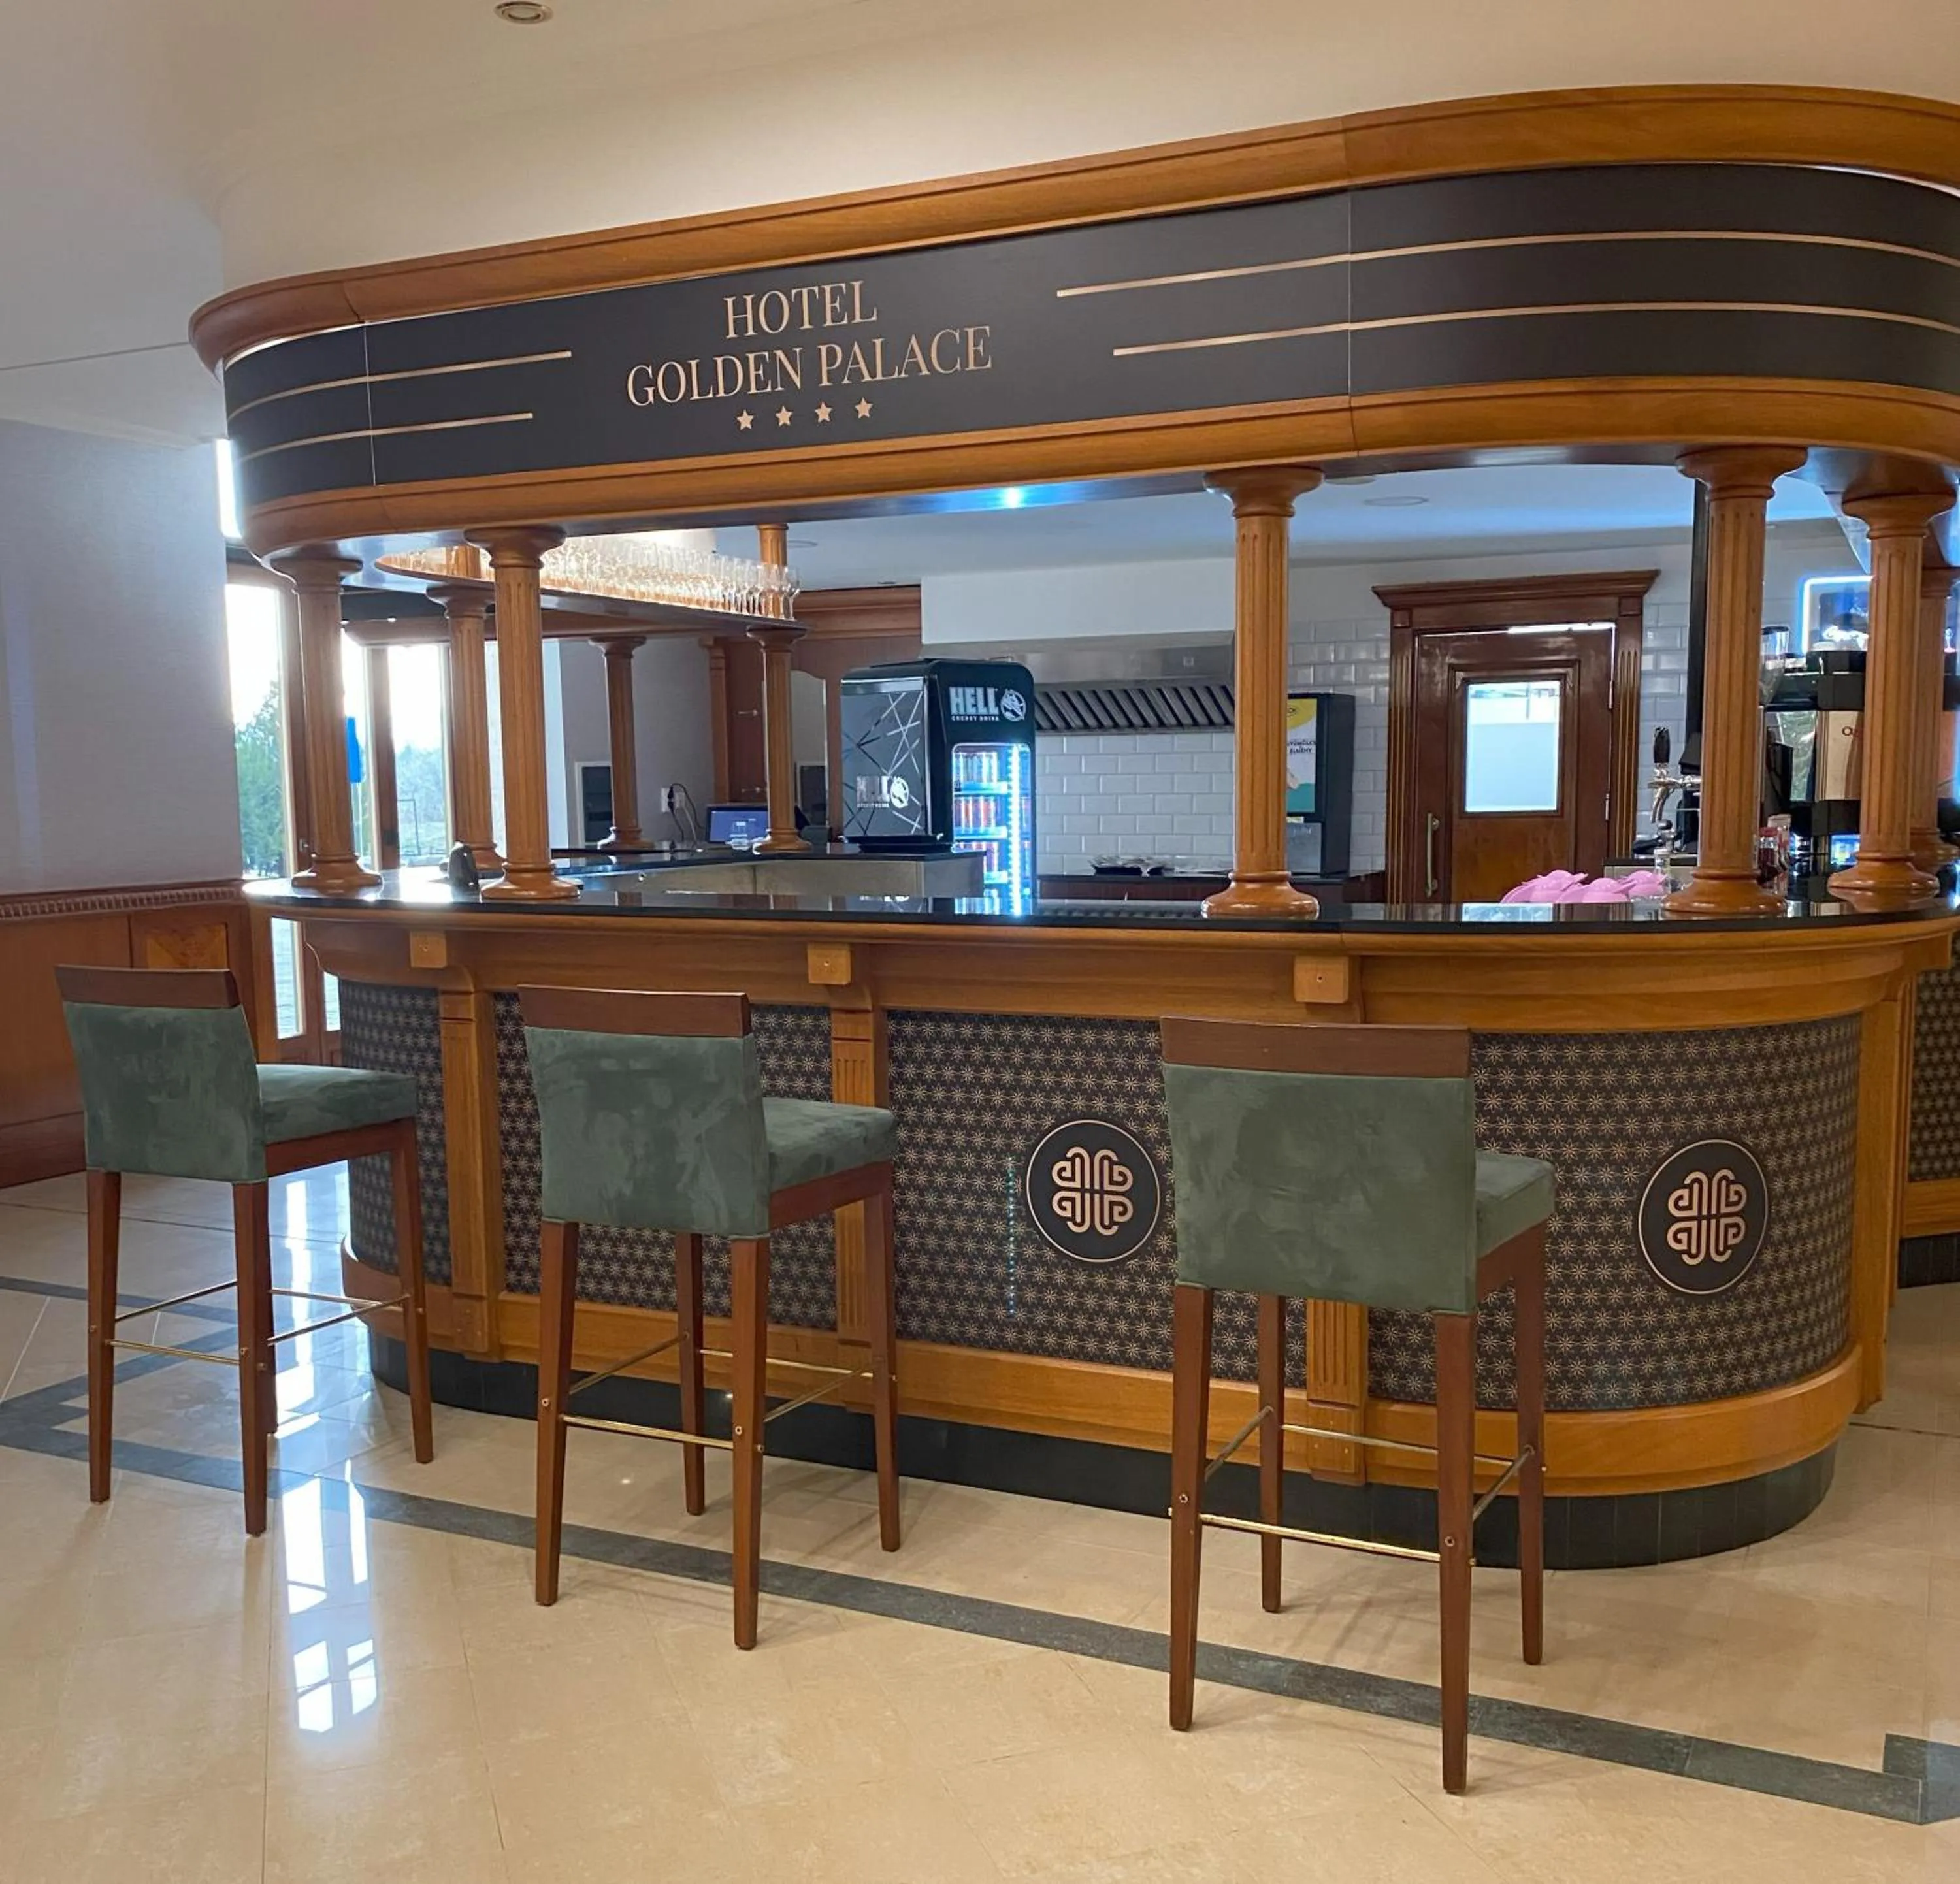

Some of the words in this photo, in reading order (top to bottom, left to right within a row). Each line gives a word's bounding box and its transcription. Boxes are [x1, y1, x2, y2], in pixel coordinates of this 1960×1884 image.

[724, 280, 877, 339] HOTEL
[627, 347, 804, 407] GOLDEN
[817, 325, 992, 387] PALACE
[949, 687, 999, 715] HELL
